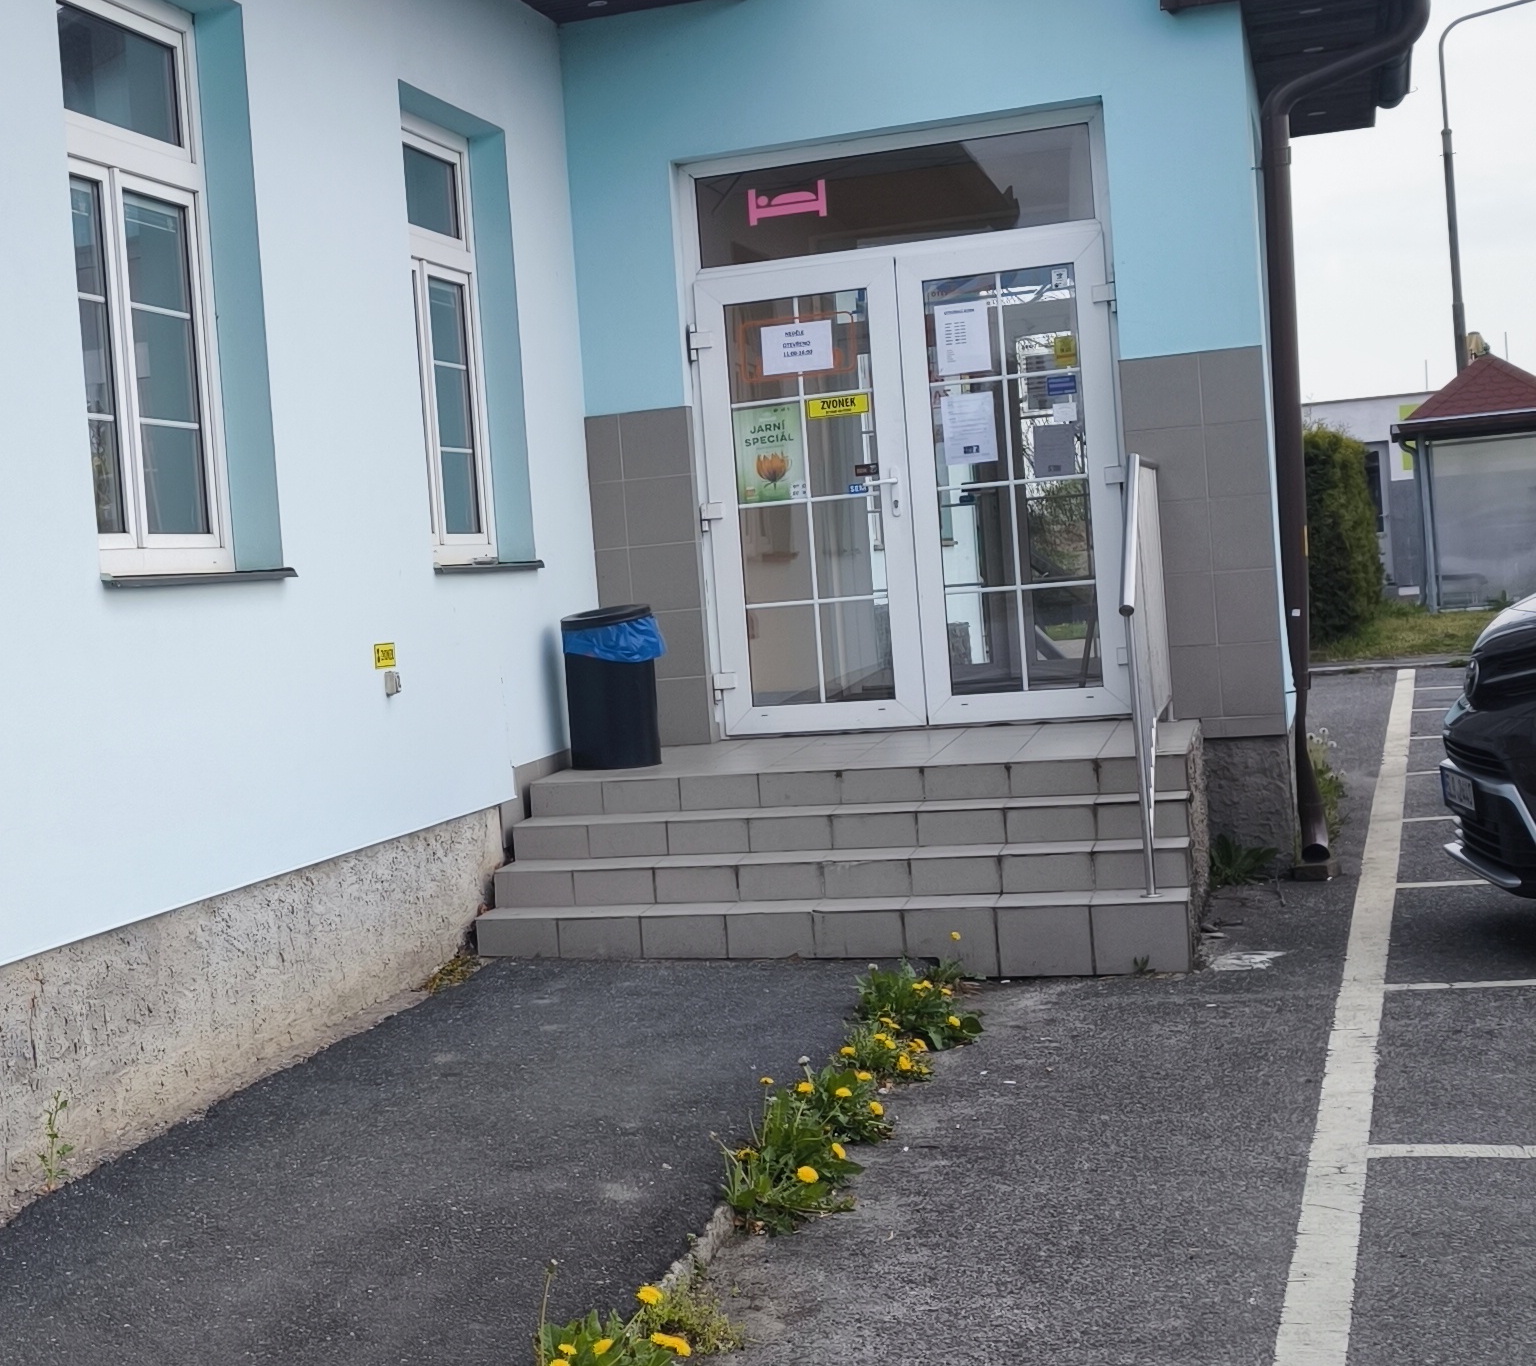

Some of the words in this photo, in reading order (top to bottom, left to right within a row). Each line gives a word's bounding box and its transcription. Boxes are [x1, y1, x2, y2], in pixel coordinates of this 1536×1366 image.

[820, 396, 856, 410] ZVONEK
[750, 419, 786, 434] JARNÍ
[744, 431, 794, 447] SPECIÁL
